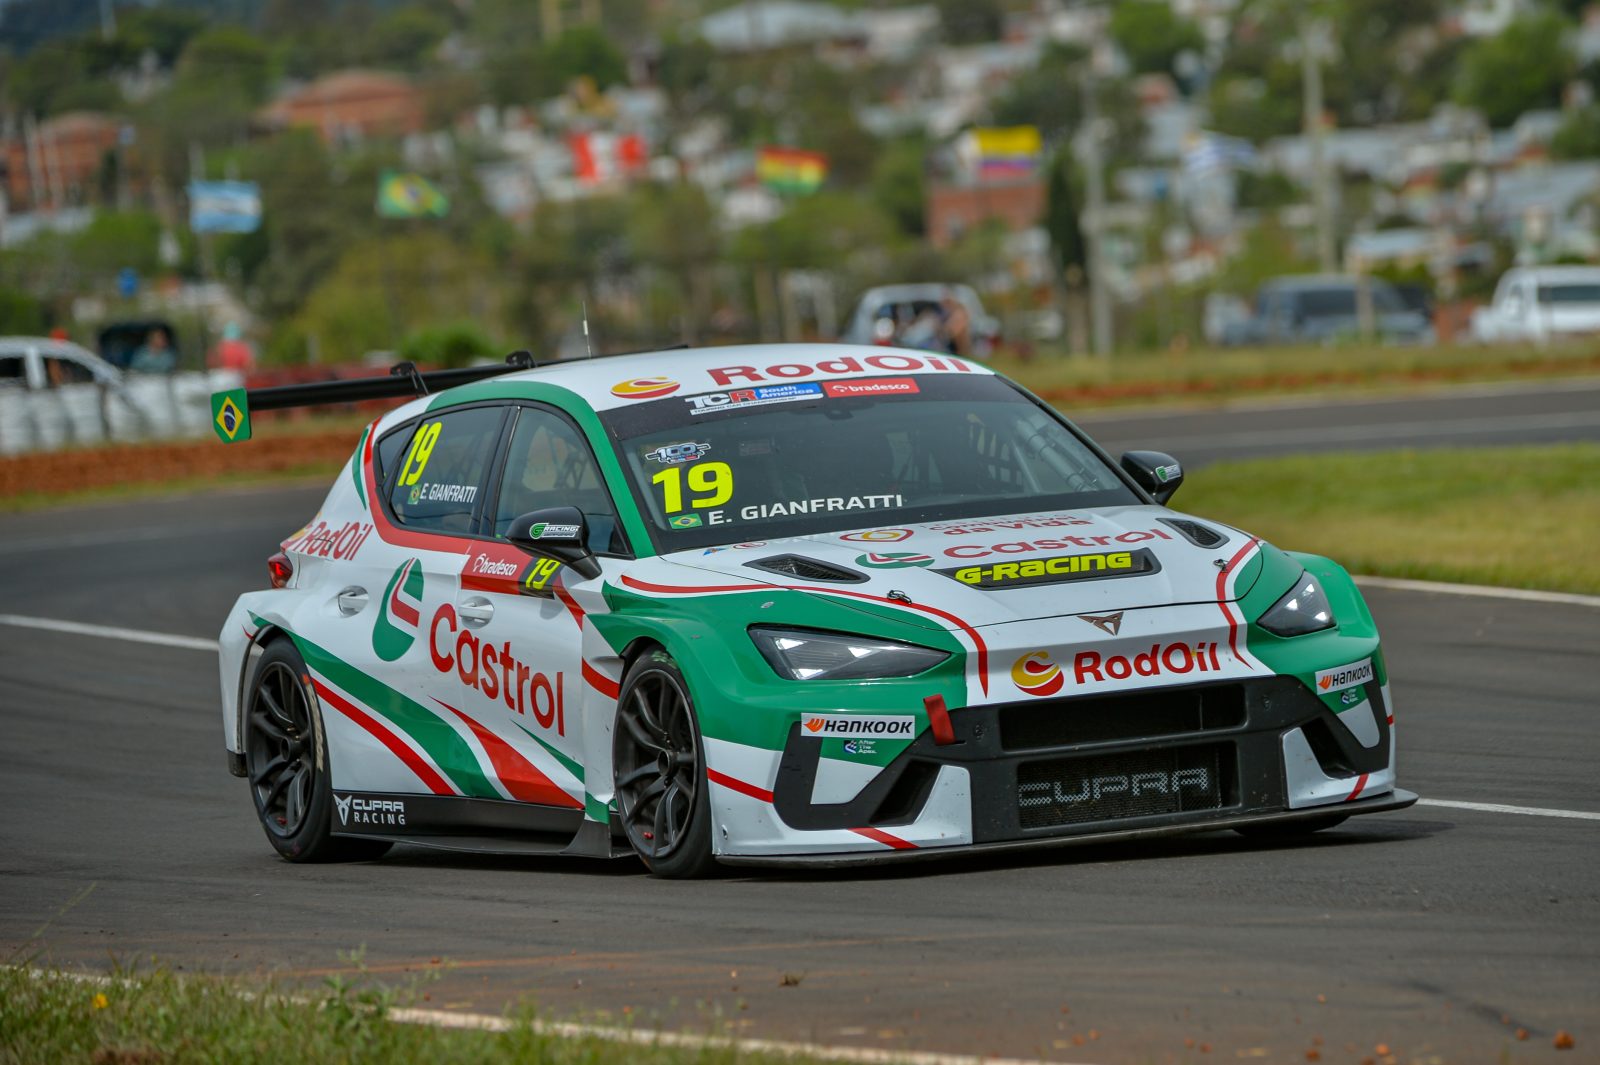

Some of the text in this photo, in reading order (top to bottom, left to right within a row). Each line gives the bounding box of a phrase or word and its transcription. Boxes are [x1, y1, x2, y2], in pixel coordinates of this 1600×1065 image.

[707, 355, 971, 386] RodOil
[685, 389, 758, 409] TCR
[759, 385, 796, 394] South
[760, 388, 814, 398] America
[848, 383, 910, 392] bradesco
[398, 421, 442, 486] 19
[657, 443, 697, 460] 100
[429, 483, 478, 503] GIANFRATTI
[652, 461, 734, 514] 19
[708, 494, 903, 525] E. GIANFRATTI
[293, 521, 374, 561] RodOil
[943, 529, 1173, 559] Castrol
[480, 558, 518, 576] bradesco
[525, 558, 561, 589] 19
[429, 603, 565, 737] Castrol
[1074, 642, 1221, 685] RodOil
[1018, 768, 1208, 806] CUPRA
[352, 799, 404, 812] CUPRA
[354, 812, 406, 825] RACING
